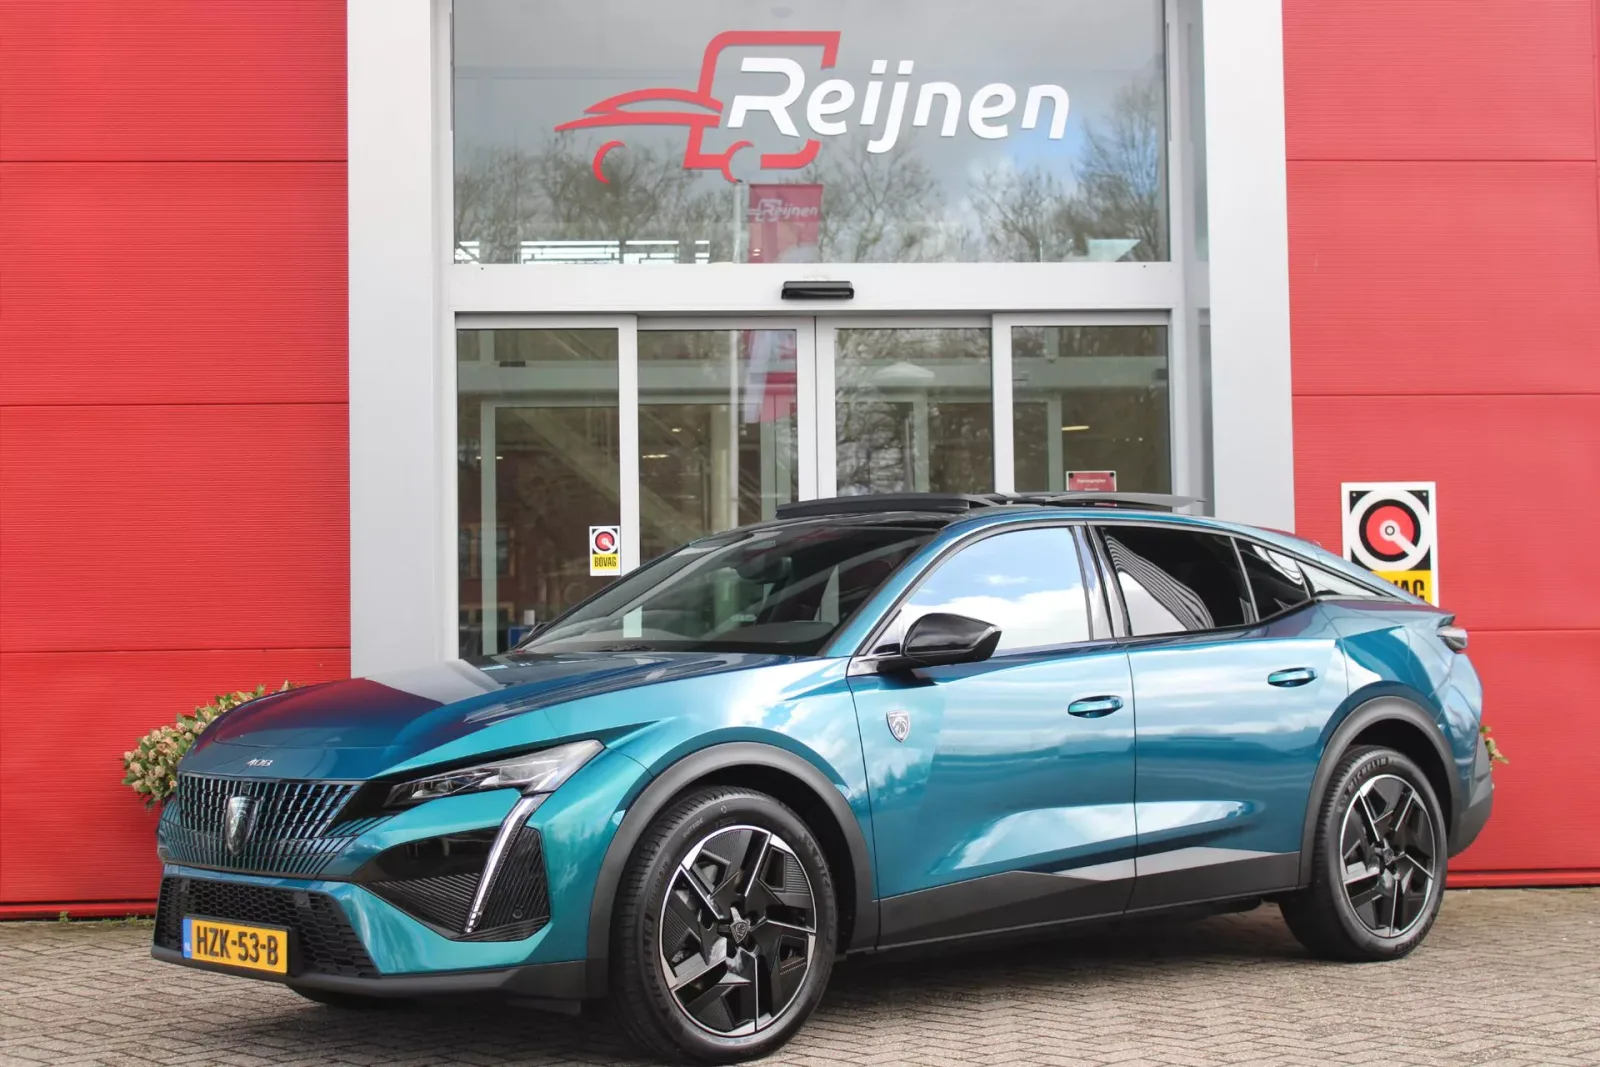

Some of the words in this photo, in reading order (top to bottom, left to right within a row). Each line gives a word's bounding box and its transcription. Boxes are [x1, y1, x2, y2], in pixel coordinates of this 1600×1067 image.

[727, 57, 1070, 153] Reijnen
[763, 202, 818, 220] Reijnen
[594, 556, 617, 568] BOVAG
[196, 925, 279, 966] HZK-53-B
